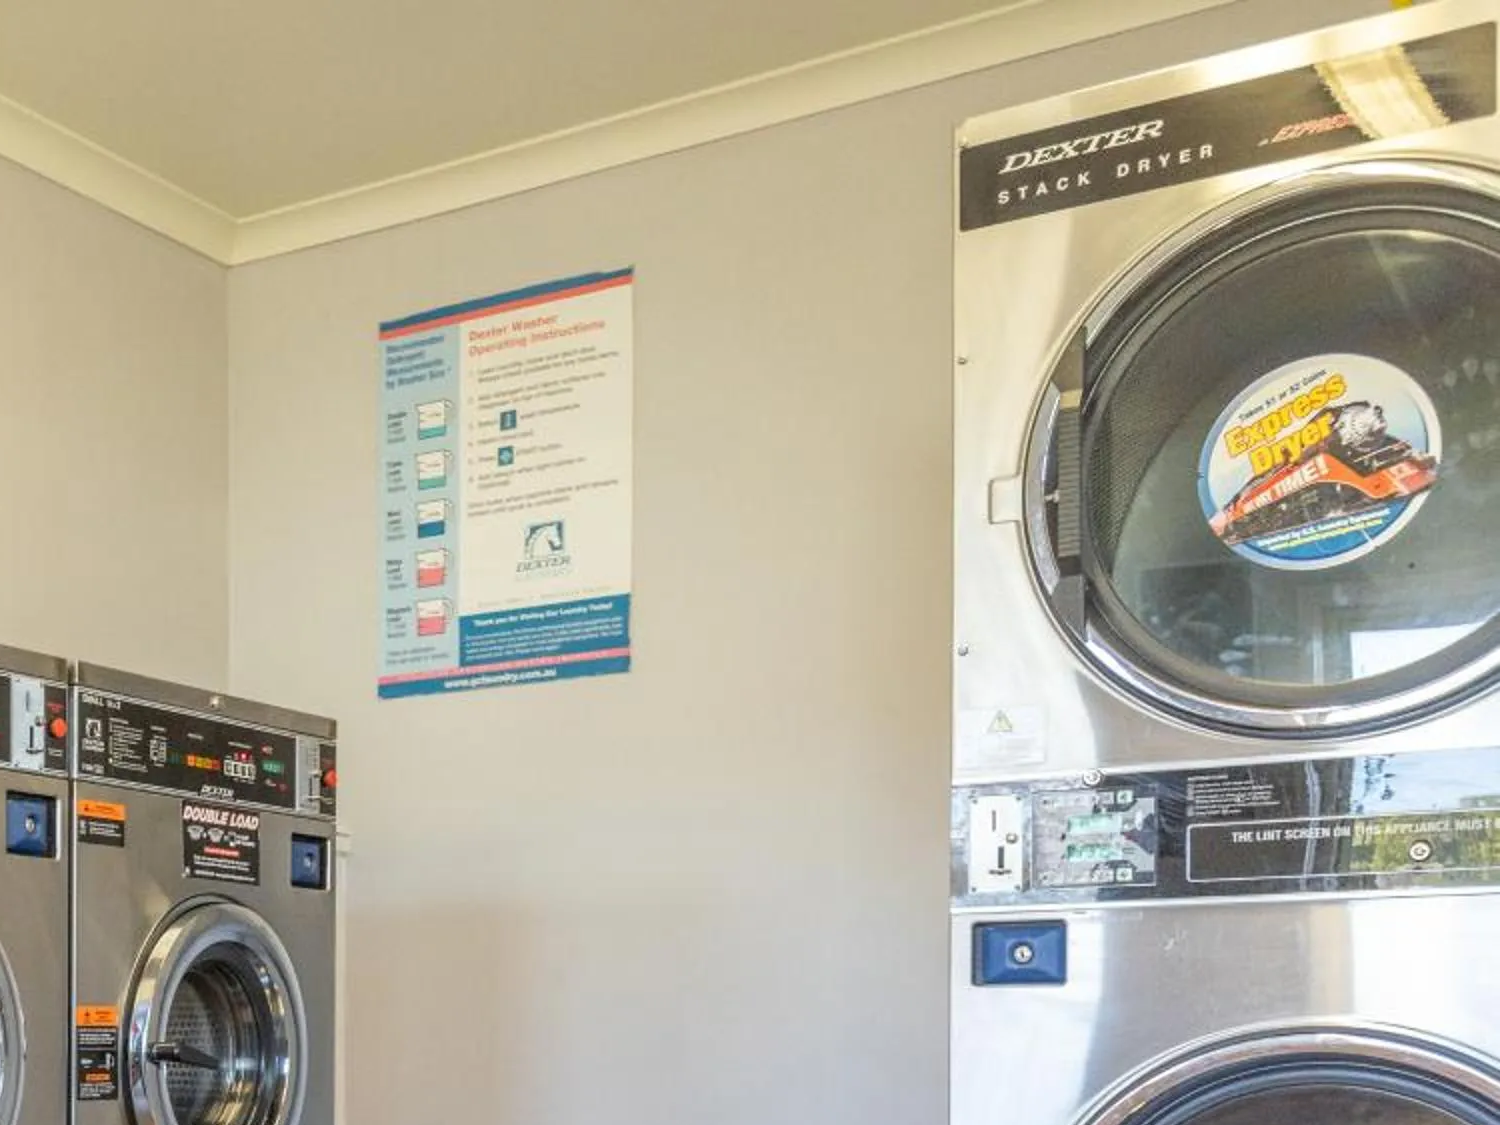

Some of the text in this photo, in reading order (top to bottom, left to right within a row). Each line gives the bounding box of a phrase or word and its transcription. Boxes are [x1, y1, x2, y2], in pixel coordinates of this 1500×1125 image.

[998, 144, 1216, 205] STACK DRYER
[999, 119, 1165, 174] DEXTER
[1224, 373, 1347, 458] Express
[1250, 411, 1334, 475] Dryer
[183, 804, 259, 831] DOUBLE LOAD
[1231, 831, 1253, 843] THE
[1255, 829, 1282, 842] LINT
[1284, 825, 1331, 841] SCREEN
